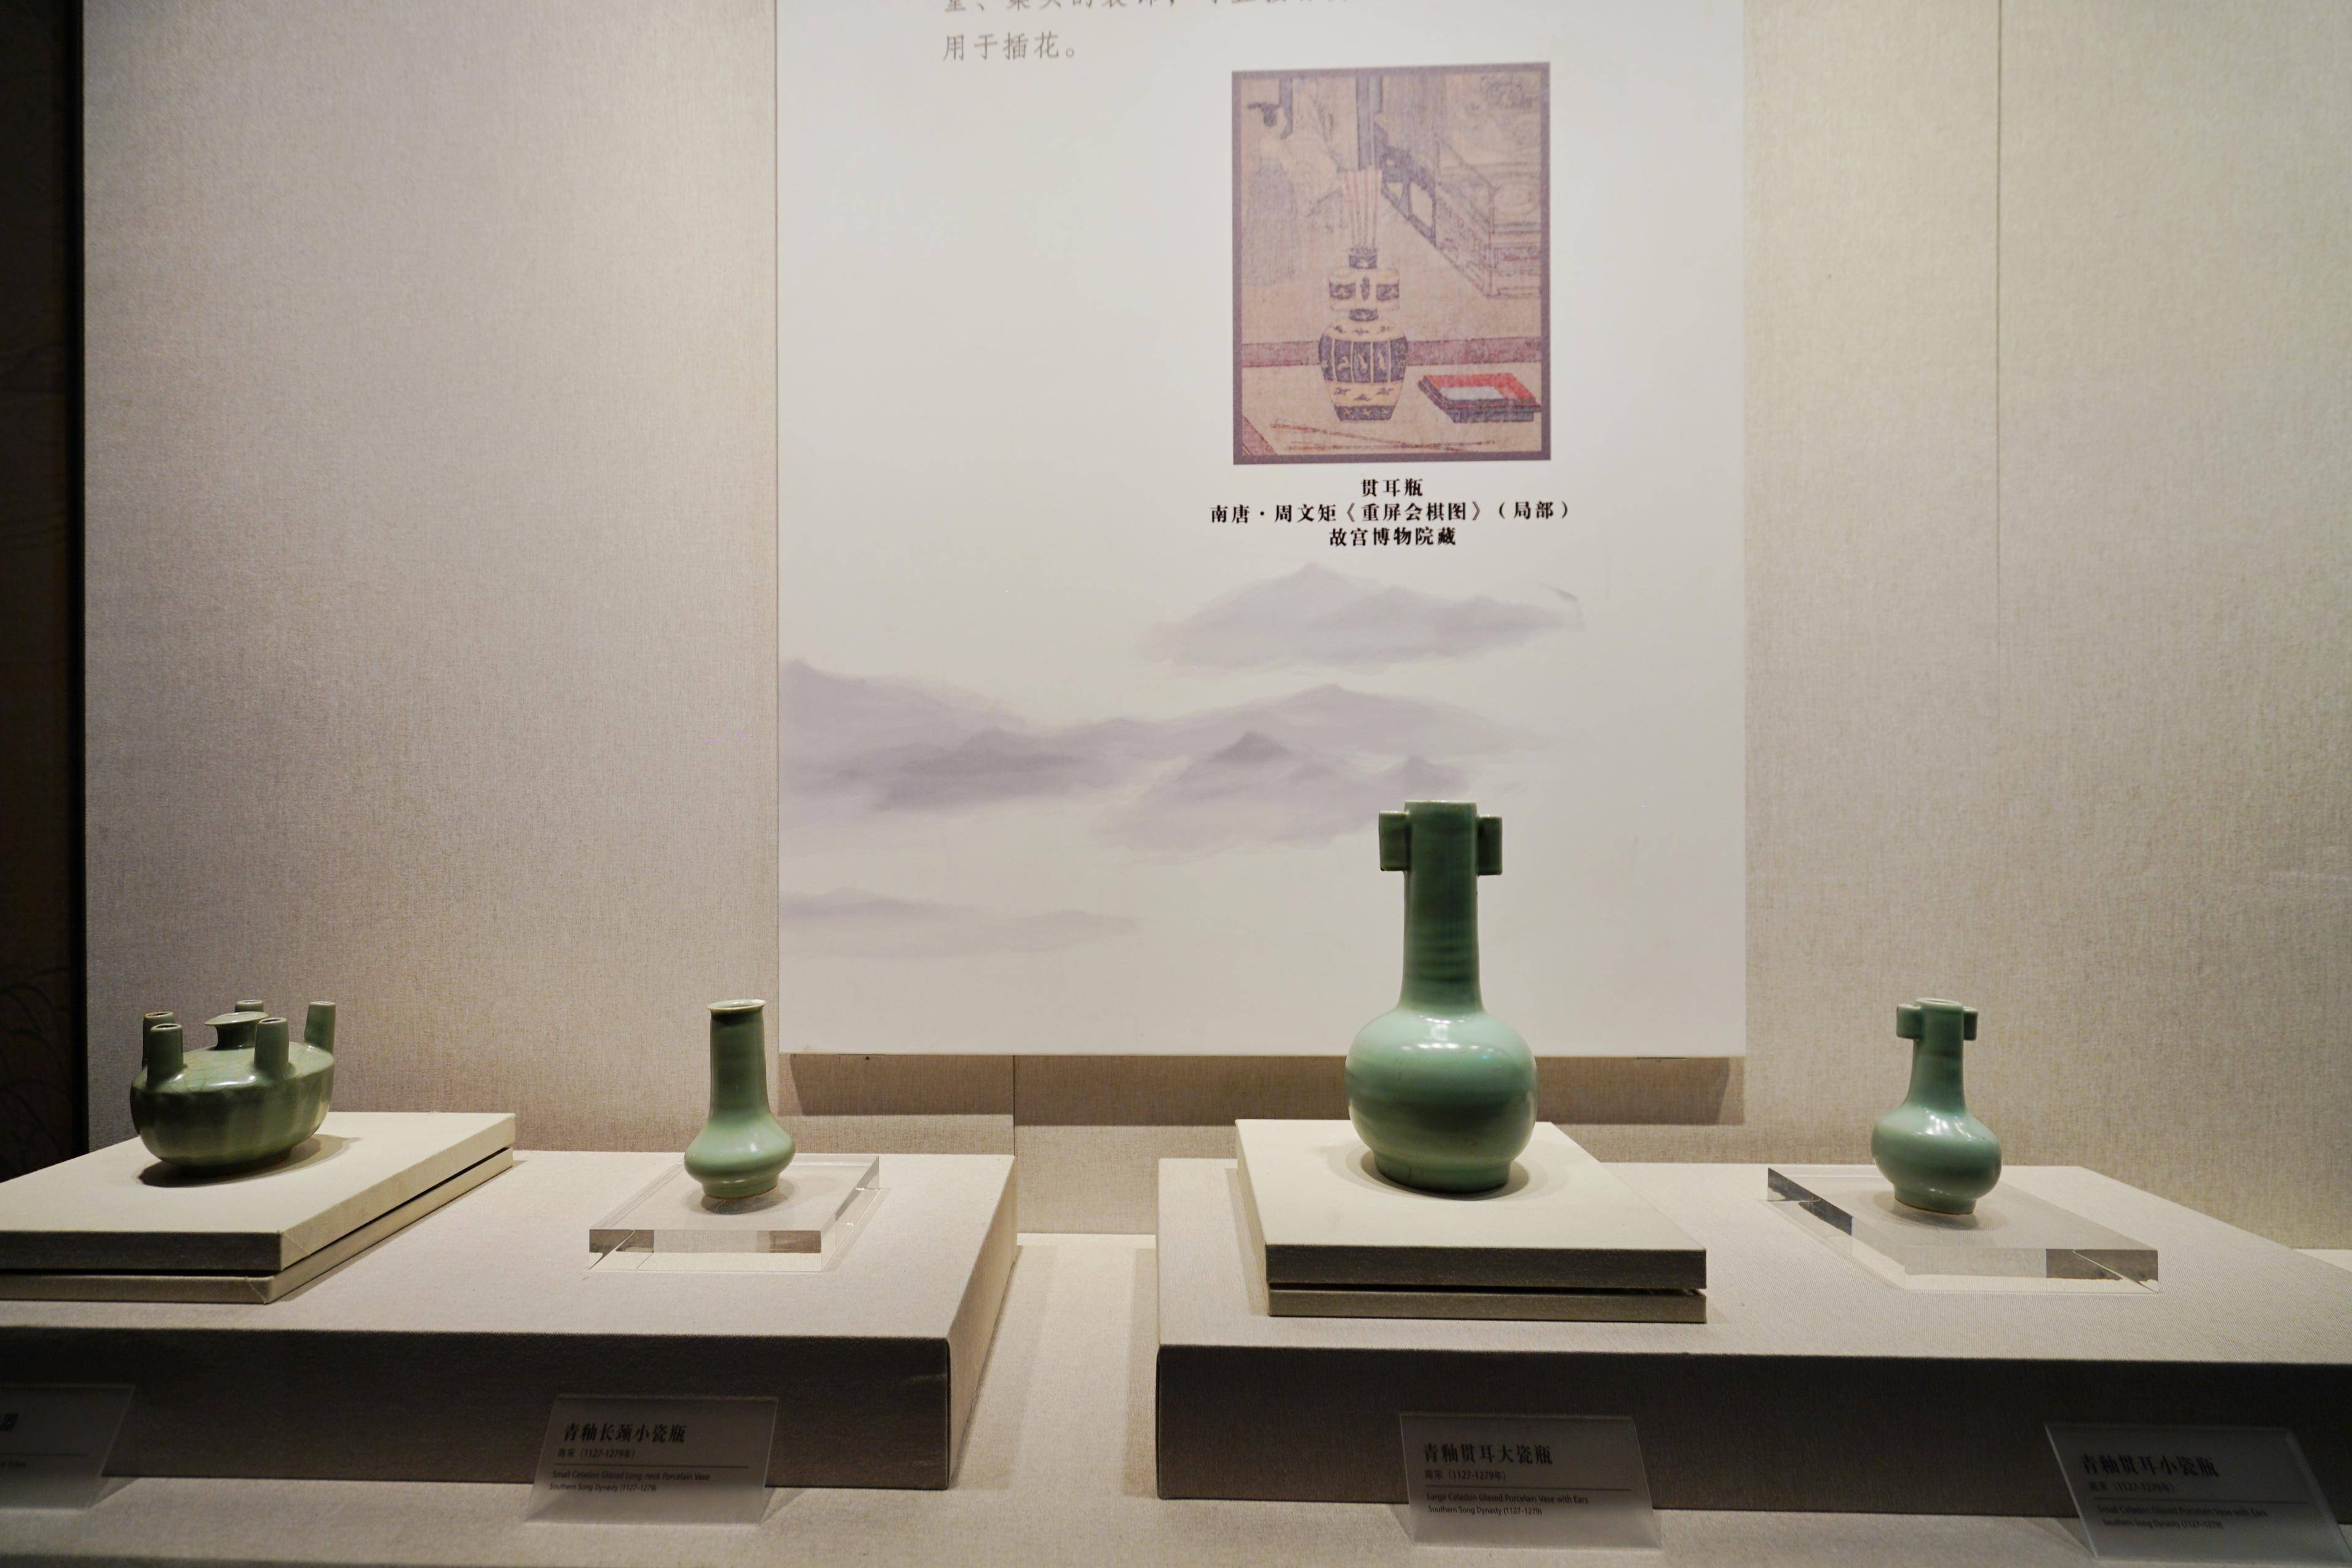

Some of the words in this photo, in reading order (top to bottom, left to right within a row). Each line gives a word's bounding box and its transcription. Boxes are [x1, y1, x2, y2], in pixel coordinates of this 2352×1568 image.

[943, 31, 1075, 61] 用于插花。
[1361, 478, 1423, 497] 贯耳瓶
[1329, 527, 1457, 546] 故宫博物院藏
[564, 1422, 687, 1443] 青釉长颈小瓷瓶
[1423, 1443, 1553, 1465] 青釉贯耳大瓷瓶
[662, 1471, 693, 1481] Porcelain
[694, 1472, 710, 1481] Vase
[577, 1483, 593, 1492] Song
[595, 1484, 619, 1492] Dynasty
[1427, 1492, 1446, 1503] Large
[1448, 1492, 1478, 1502] Celadon
[1479, 1493, 1503, 1502] Glazed
[1505, 1494, 1537, 1503] Porcelain
[1538, 1495, 1555, 1503] Vase
[1556, 1495, 1572, 1504] with
[1574, 1495, 1589, 1505] Ears
[1428, 1505, 1457, 1513] Southern
[1459, 1506, 1475, 1515] Song
[1477, 1506, 1502, 1516] Dynasty
